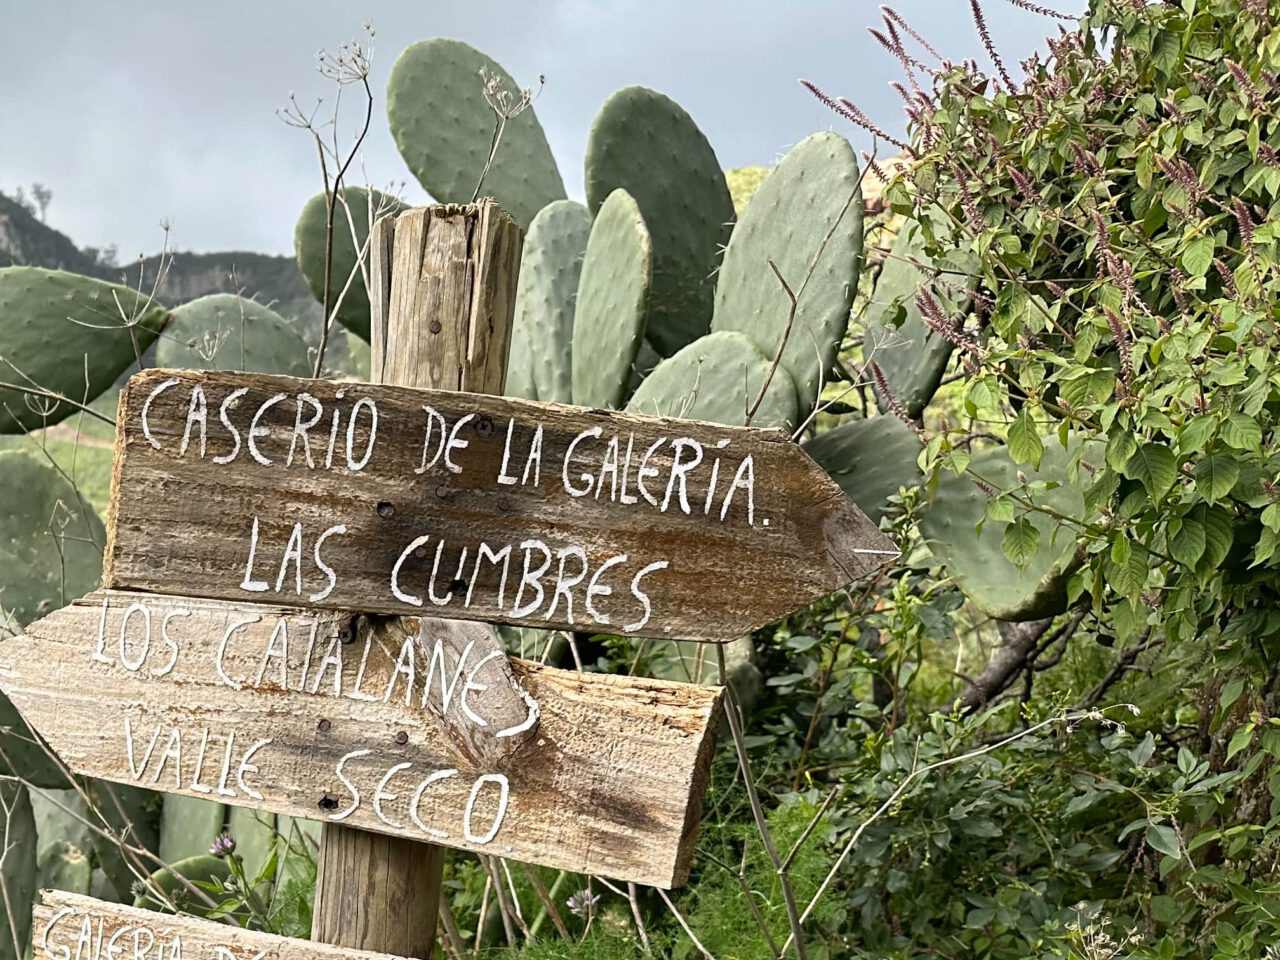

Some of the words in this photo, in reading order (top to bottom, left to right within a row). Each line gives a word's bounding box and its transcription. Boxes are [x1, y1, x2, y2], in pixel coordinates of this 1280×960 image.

[414, 404, 476, 474] DE
[498, 417, 543, 488] LA
[239, 516, 347, 603] LAS
[390, 534, 668, 633] CUMBRES
[91, 598, 192, 676] LOS
[216, 614, 541, 738] CATALANES
[124, 717, 274, 800] VALLE
[328, 749, 510, 844] SECO
